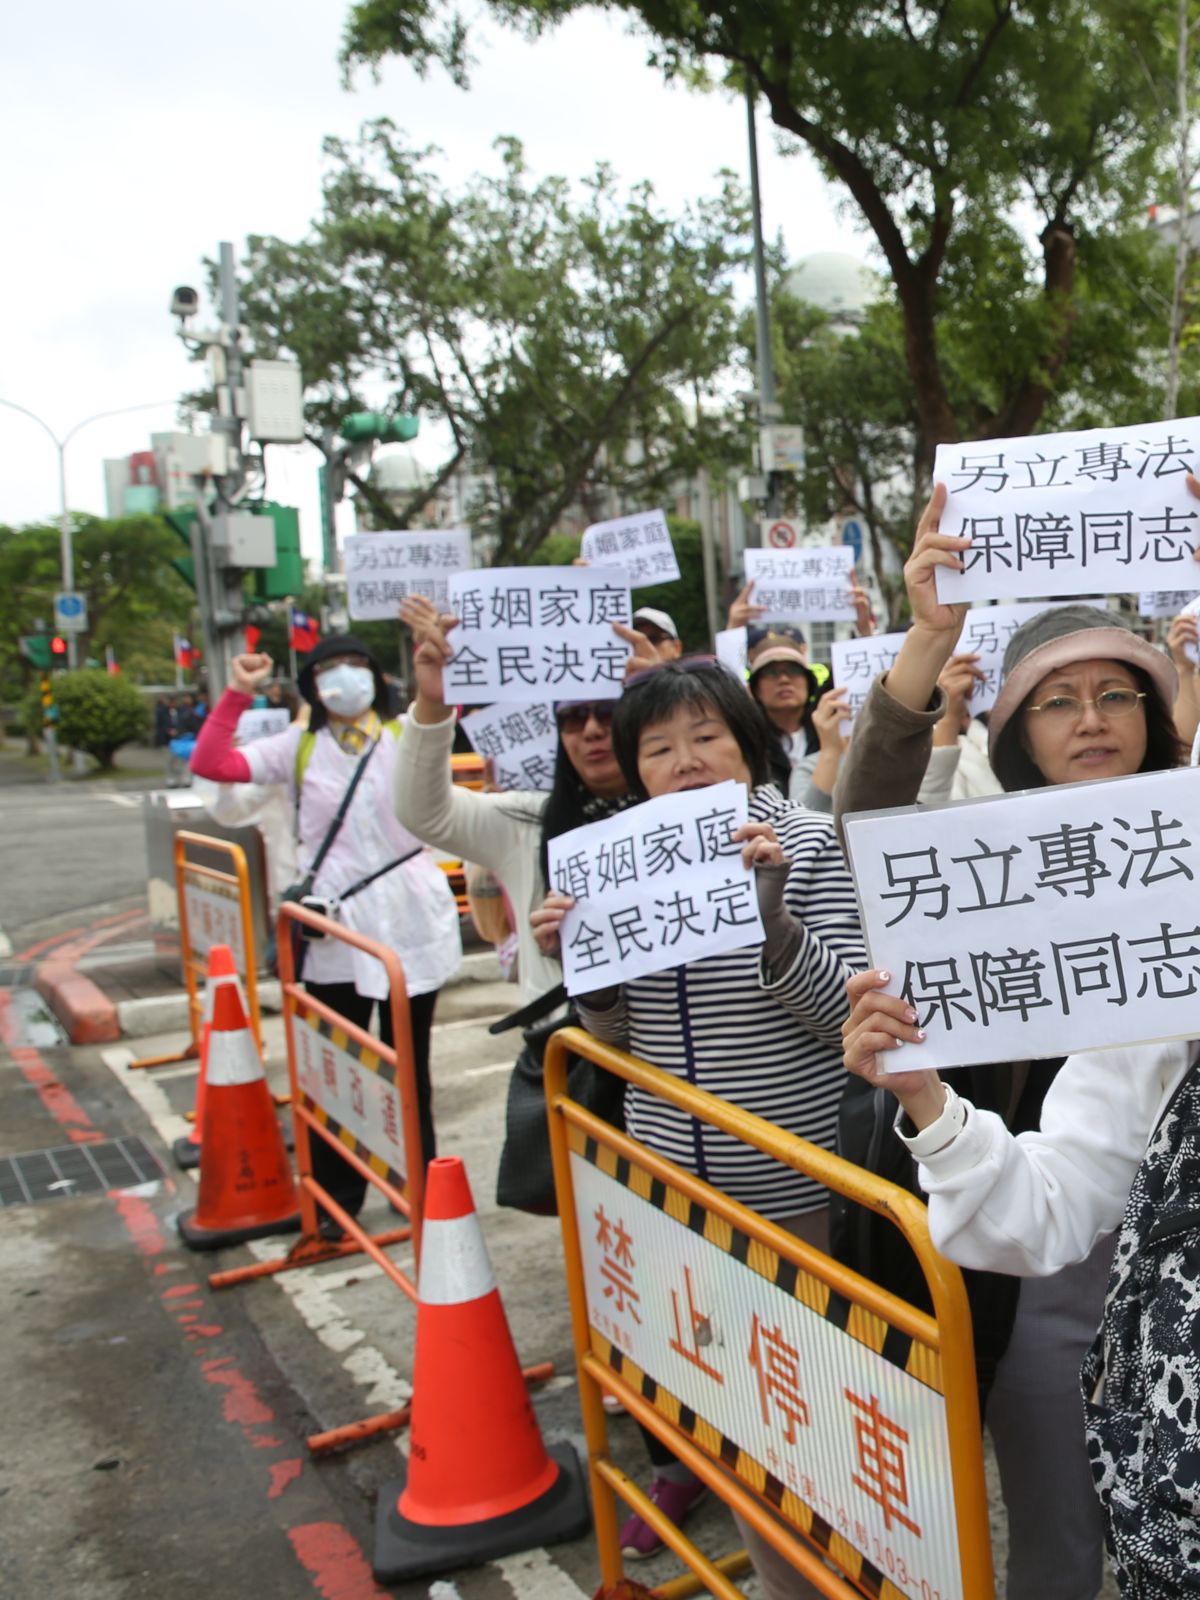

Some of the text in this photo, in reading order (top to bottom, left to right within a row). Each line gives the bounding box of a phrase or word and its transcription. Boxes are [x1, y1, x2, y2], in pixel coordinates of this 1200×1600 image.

[950, 435, 1195, 493] 另立專法
[352, 543, 460, 572] 另立專法
[755, 557, 848, 579] 另立專法
[958, 507, 1199, 574] 保障同志
[452, 584, 628, 631] 婚姻家庭
[440, 641, 629, 687] 全民決定
[554, 808, 744, 902] 婚姻家庭
[879, 810, 1194, 927] 另立專法
[569, 878, 758, 973] 全民決定
[594, 1203, 922, 1539] 禁止停車
